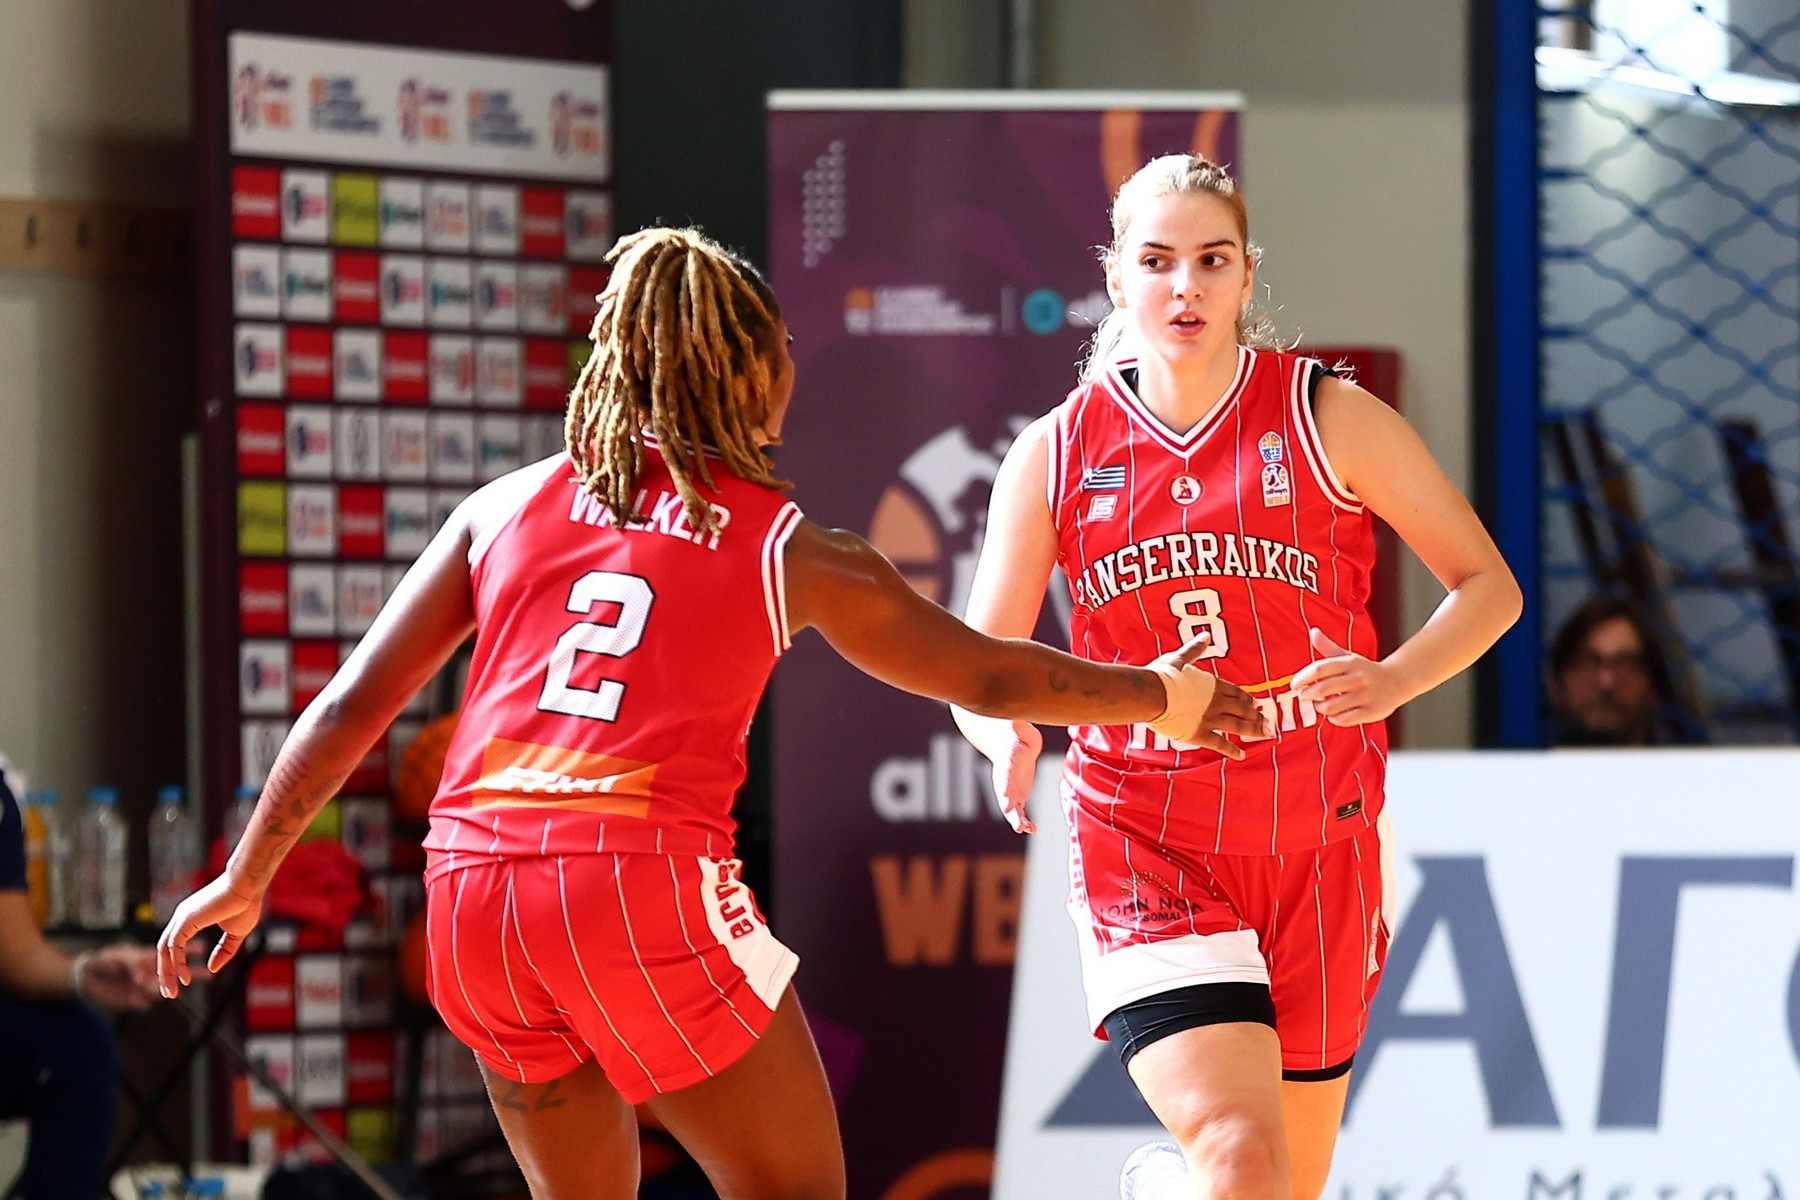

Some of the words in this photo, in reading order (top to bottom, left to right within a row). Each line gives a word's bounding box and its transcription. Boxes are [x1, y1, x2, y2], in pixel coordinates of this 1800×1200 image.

[569, 484, 731, 551] WLKER
[1076, 532, 1320, 613] PANSERRAIKOS
[536, 570, 656, 723] 2
[1168, 587, 1230, 660] 8
[1100, 898, 1150, 917] OHN
